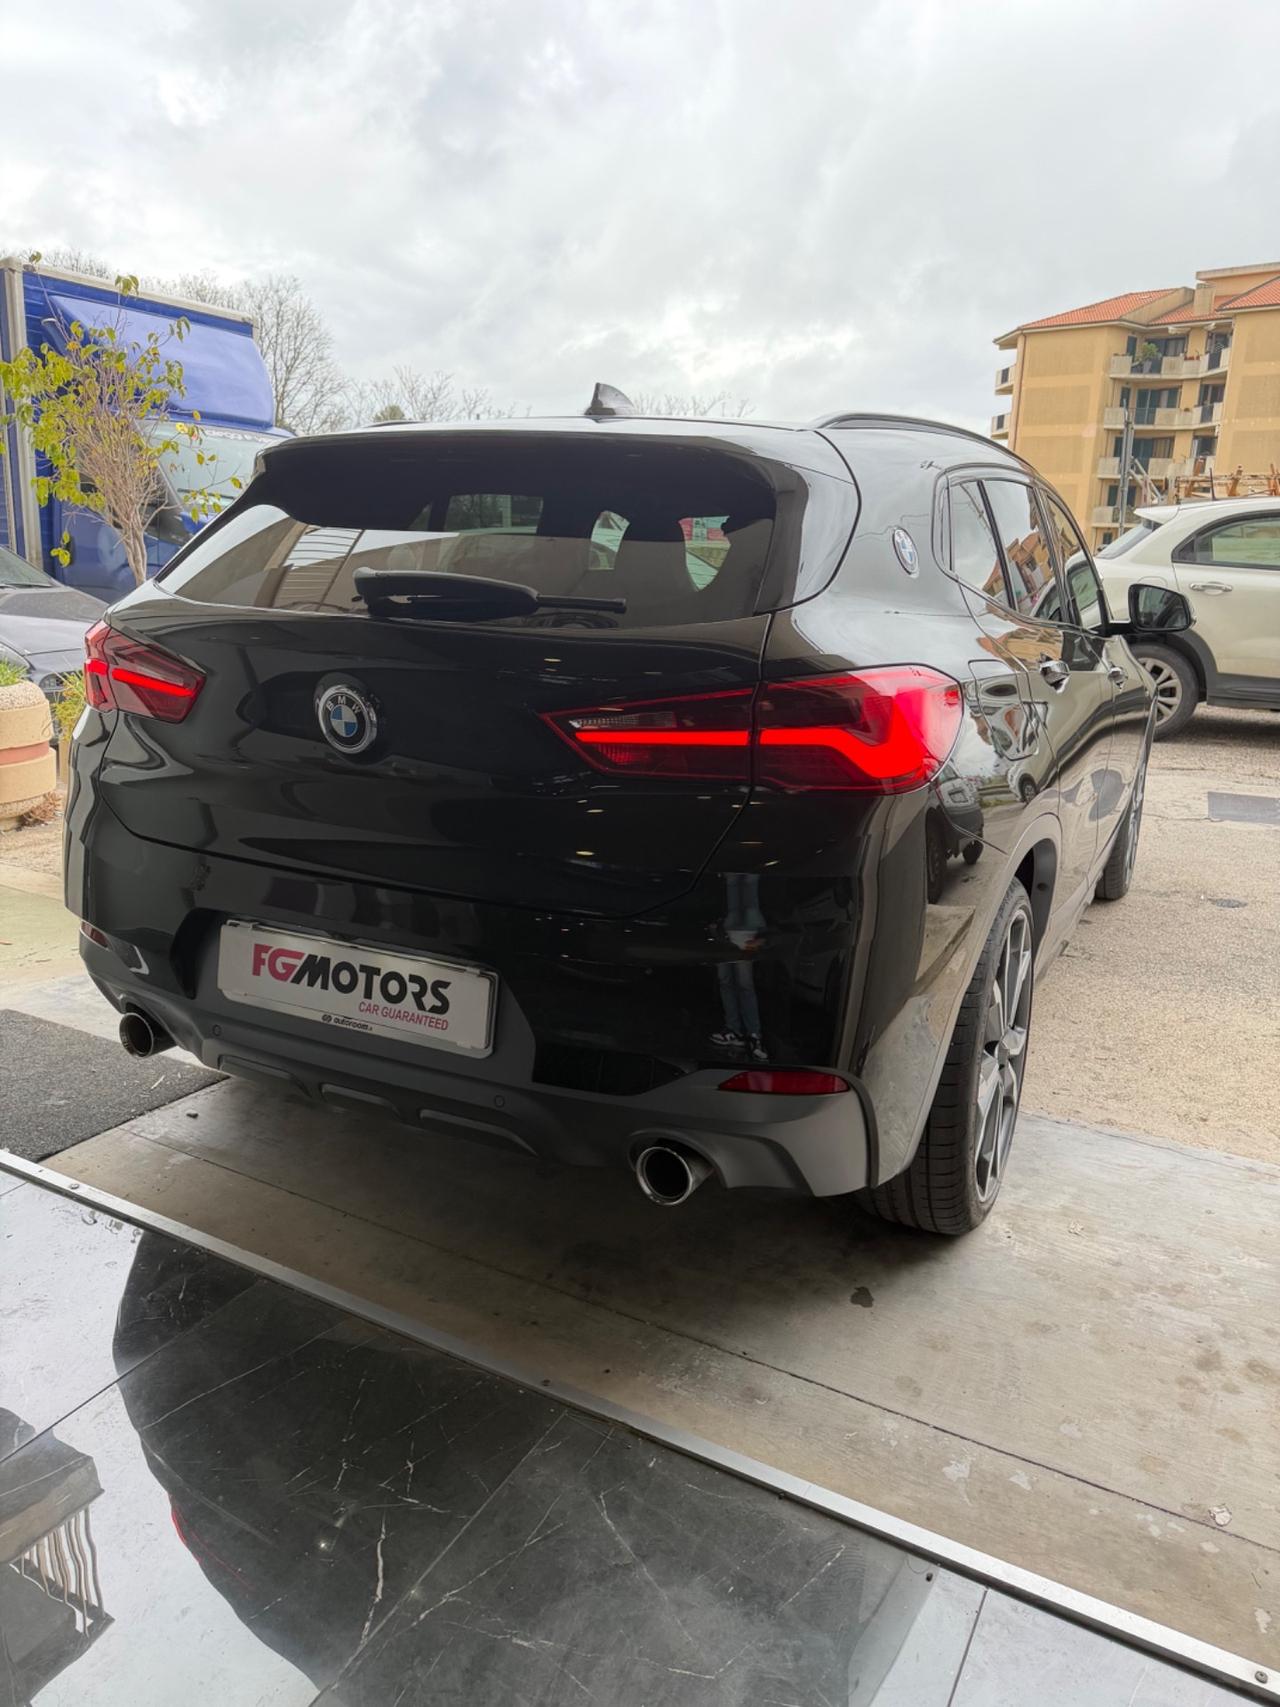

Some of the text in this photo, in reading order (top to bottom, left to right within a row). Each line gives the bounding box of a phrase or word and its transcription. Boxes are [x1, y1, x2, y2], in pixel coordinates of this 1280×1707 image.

[326, 695, 362, 713] BMW
[358, 1001, 449, 1031] CAR GUARANTEED
